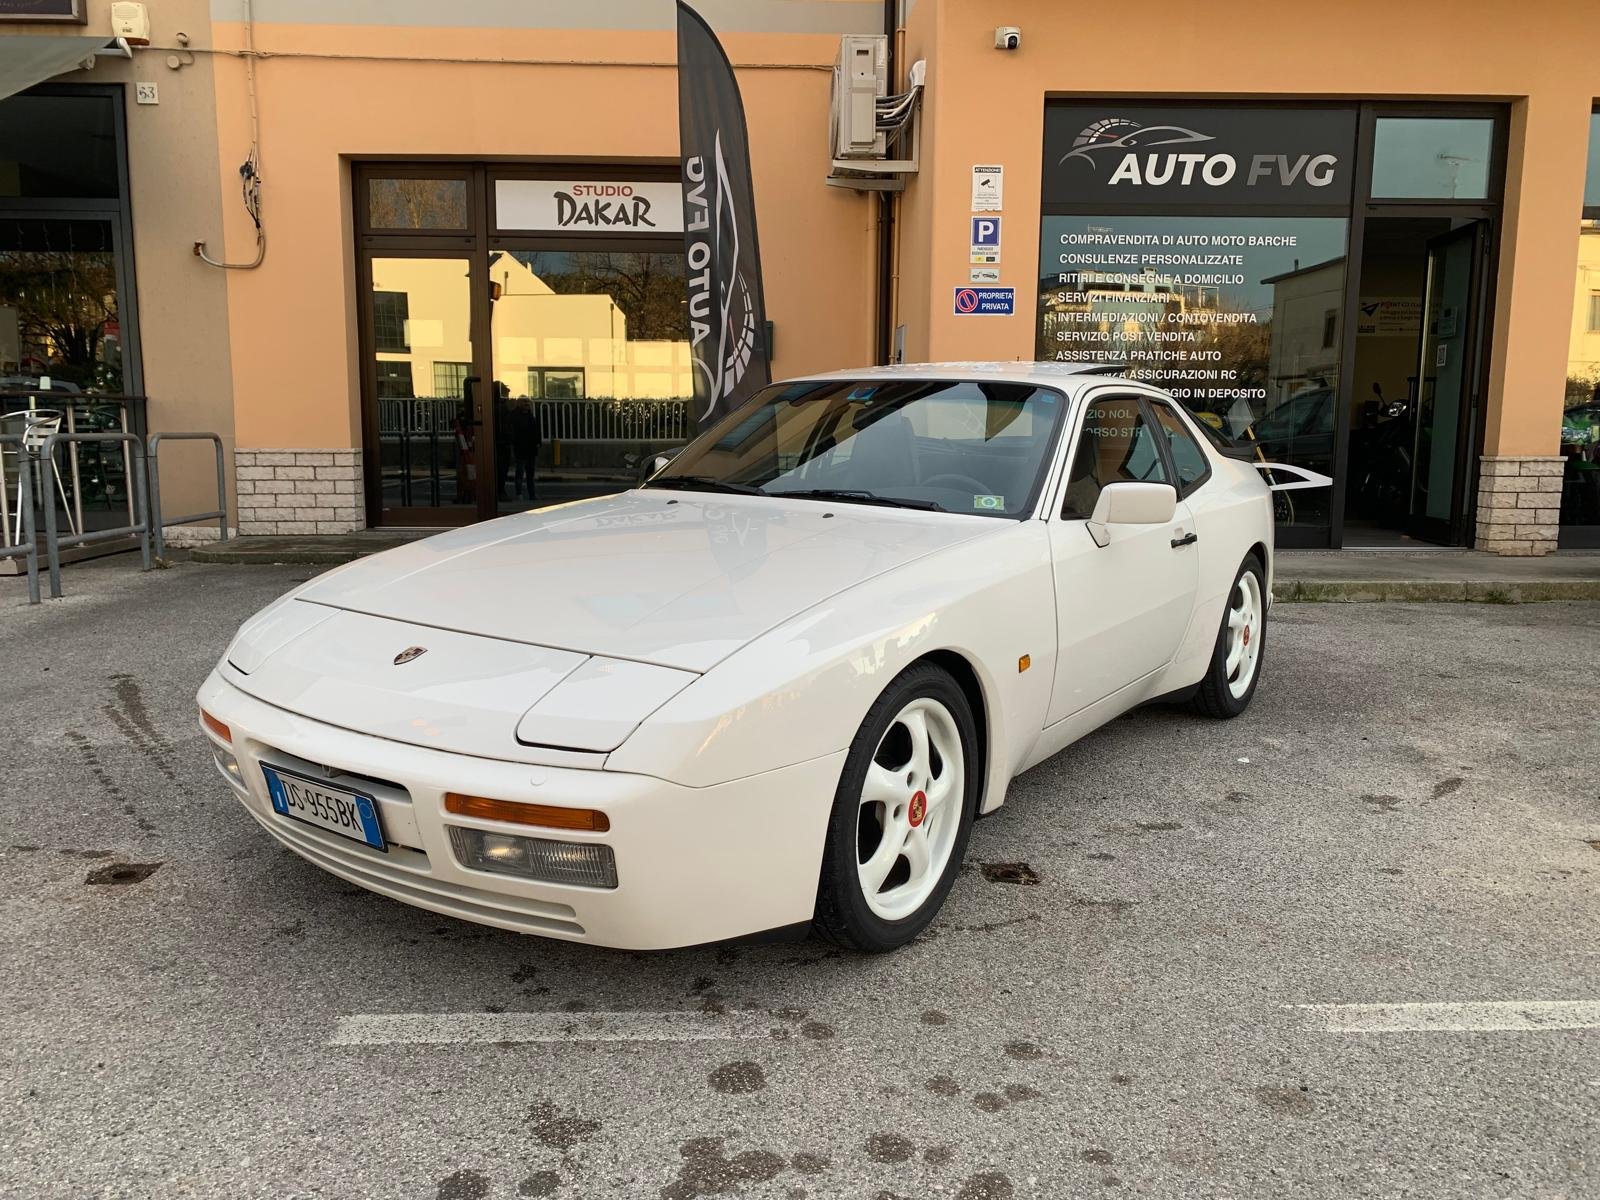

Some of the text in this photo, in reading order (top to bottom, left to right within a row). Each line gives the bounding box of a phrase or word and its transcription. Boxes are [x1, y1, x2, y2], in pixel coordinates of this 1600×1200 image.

[1108, 153, 1338, 187] AUTO FVG
[573, 185, 633, 196] STUDIO
[553, 191, 656, 227] DAKAR
[978, 221, 994, 242] P
[1060, 234, 1297, 246] COMPRAVENDITA DI AUTO MOTO BARCHE
[1060, 254, 1243, 265] CONSULENZE PERSONALIZZATE
[1059, 273, 1244, 284] RITIRI E CONSEGNE A DOMICILIO
[1058, 292, 1169, 303] SERVIZI FINANZIARI
[981, 302, 1009, 310] PRIVATA
[1057, 312, 1159, 323] INTERMEDIAZIONI
[1167, 313, 1257, 323] CONTOVENDITA
[1056, 331, 1195, 342] SERVIZIO POST VENDITA
[1056, 350, 1222, 361] ASSISTENZA PRATICHE AUTO
[1129, 369, 1218, 380] ASSICURAZIONI
[1220, 370, 1237, 380] RC
[1193, 388, 1206, 398] IN
[1208, 388, 1266, 398] DEPOSITO
